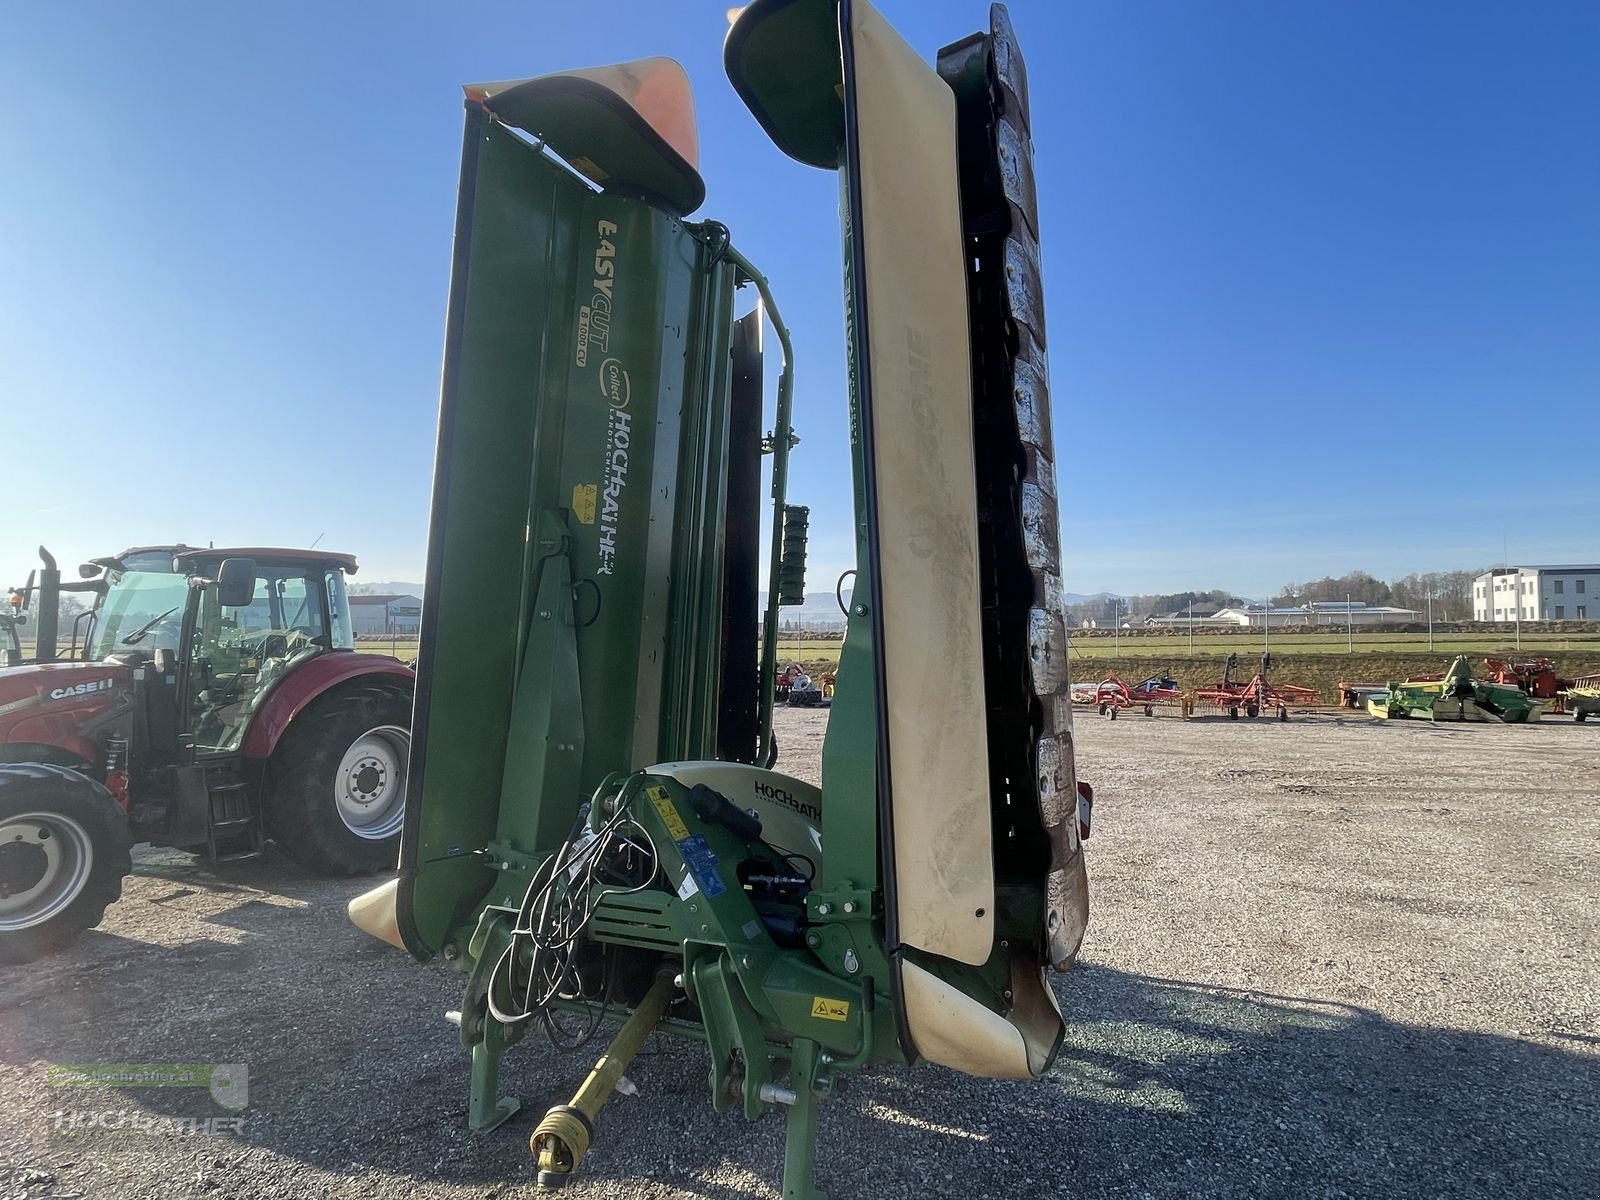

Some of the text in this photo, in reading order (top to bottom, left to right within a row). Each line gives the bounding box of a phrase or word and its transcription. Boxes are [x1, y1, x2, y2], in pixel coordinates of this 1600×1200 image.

[589, 219, 618, 352] EASYCUT
[578, 322, 588, 346] 1000
[577, 349, 586, 365] CV
[50, 682, 98, 700] CASE
